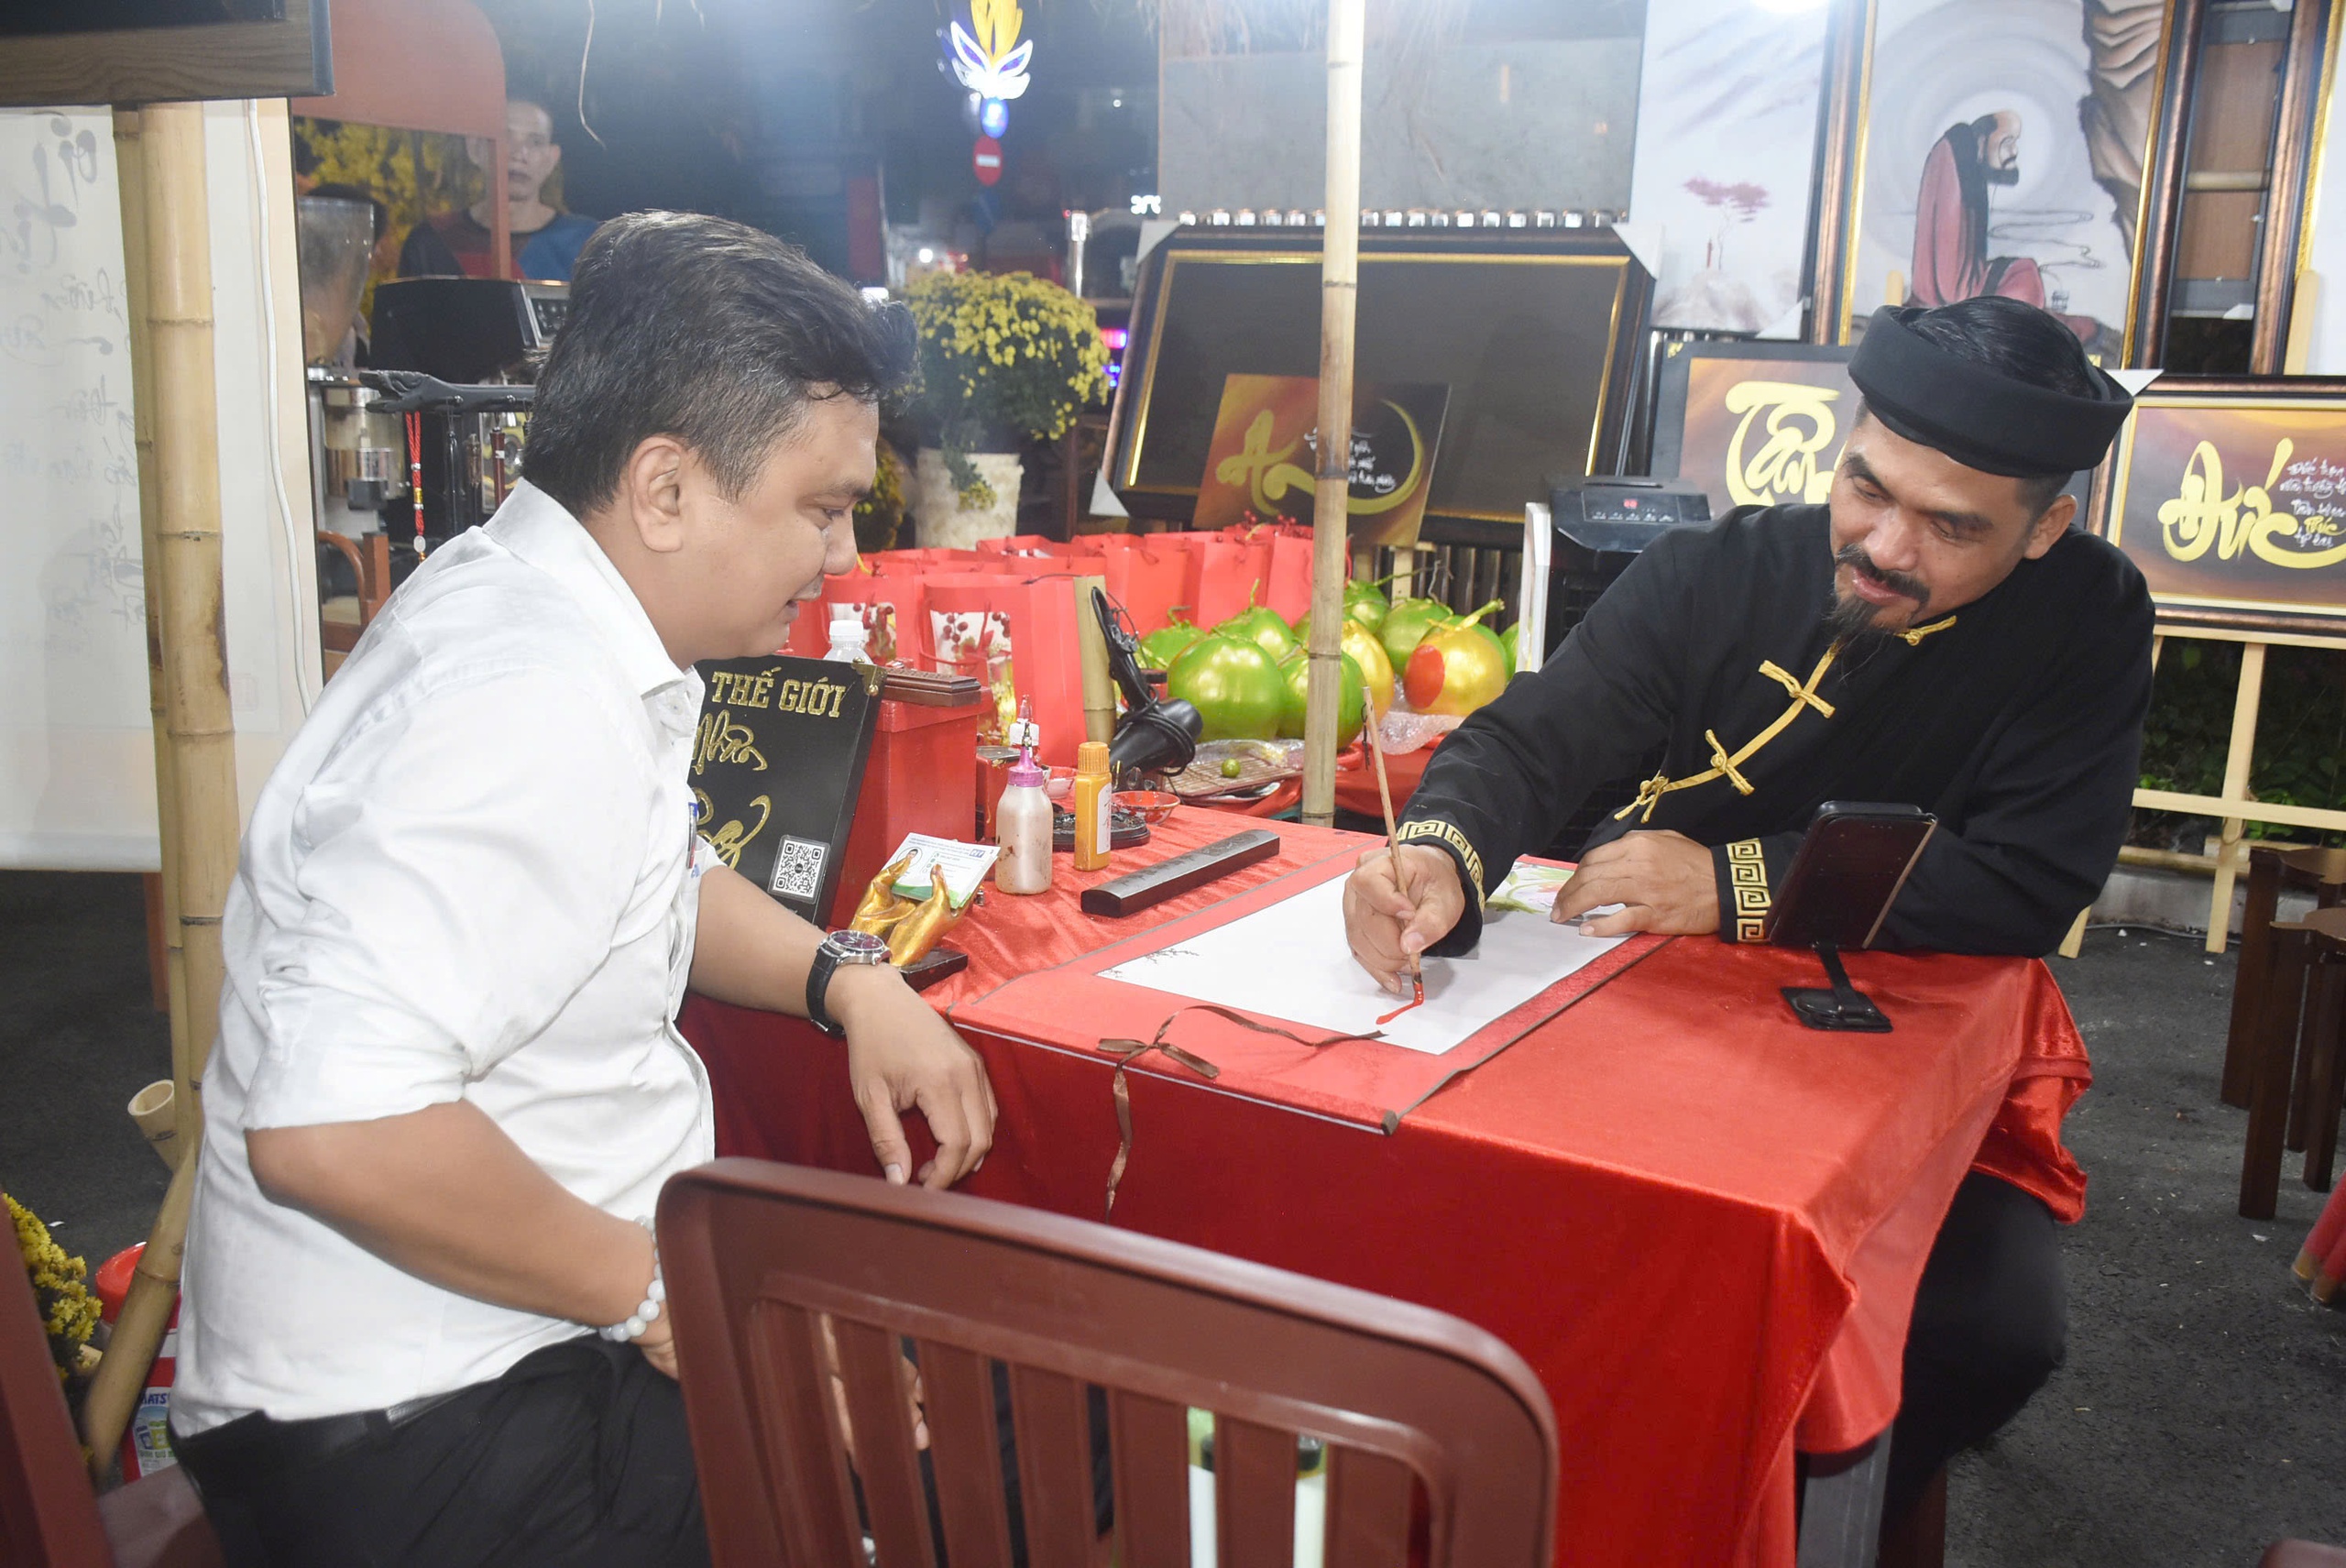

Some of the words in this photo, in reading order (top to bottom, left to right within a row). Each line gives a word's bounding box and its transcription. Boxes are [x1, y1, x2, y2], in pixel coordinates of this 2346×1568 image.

[2157, 437, 2346, 569] Đức
[711, 666, 782, 708] THẾ
[778, 677, 846, 718] GIỚI
